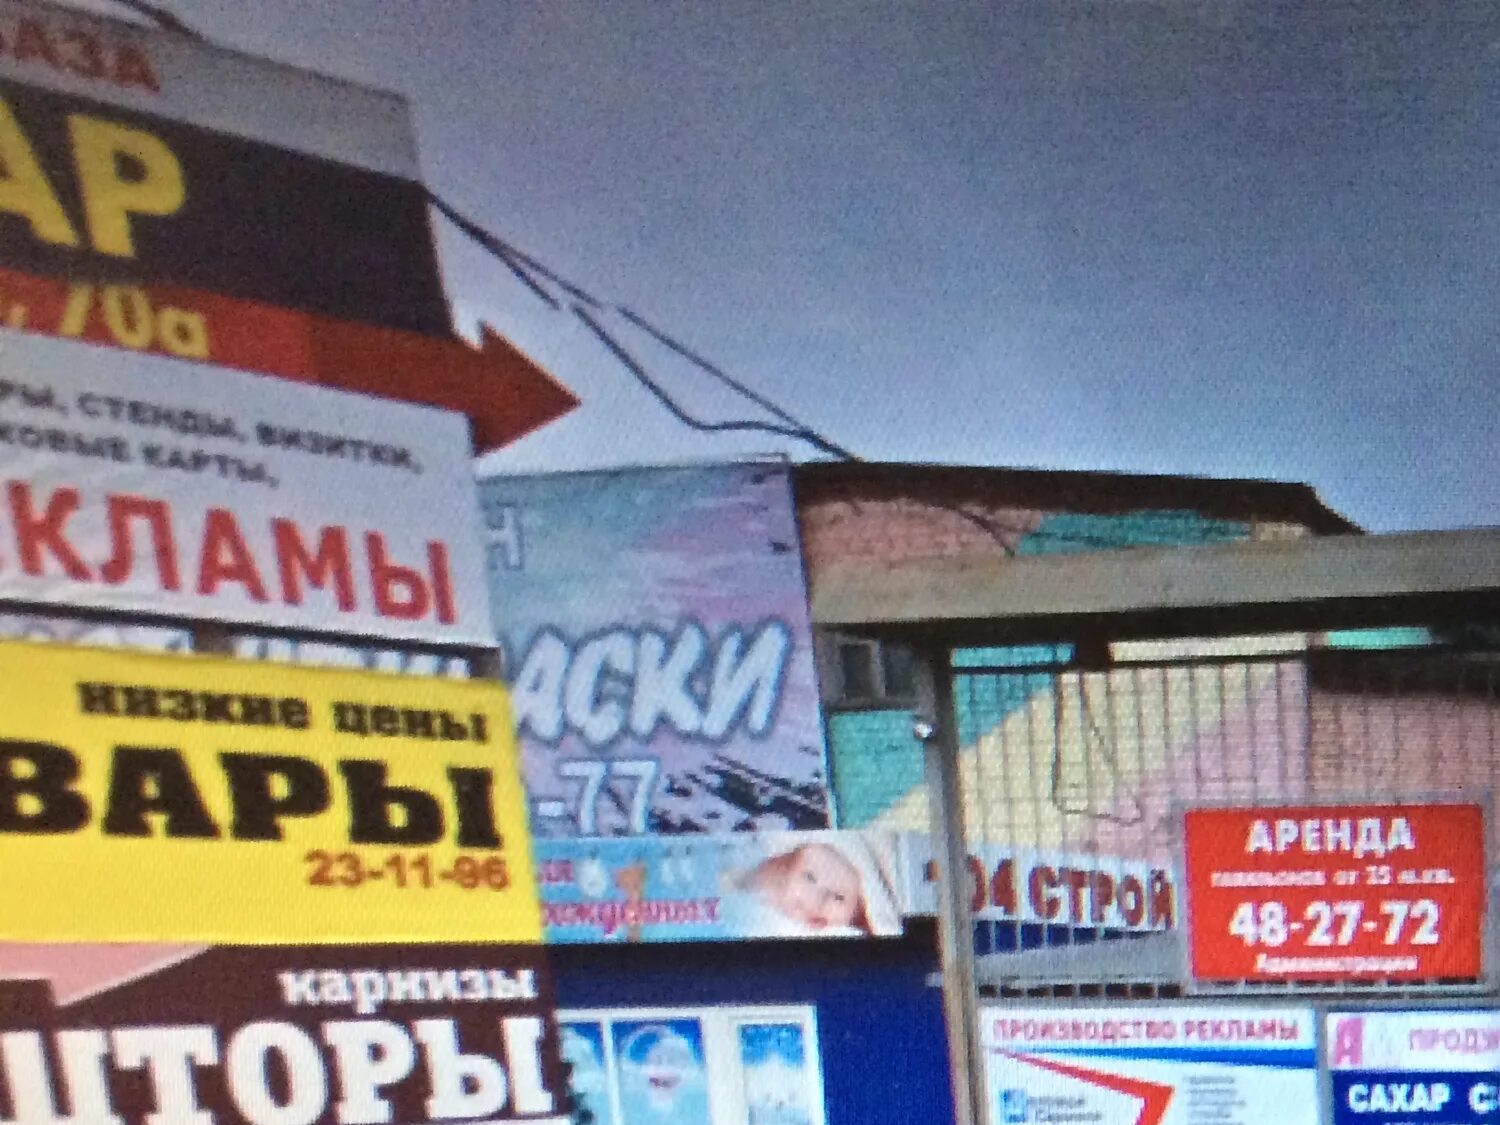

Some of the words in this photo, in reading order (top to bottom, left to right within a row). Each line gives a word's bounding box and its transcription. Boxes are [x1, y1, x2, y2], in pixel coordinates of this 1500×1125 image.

[78, 682, 313, 730] низкие
[332, 702, 489, 743] цены
[0, 740, 503, 850] ВАРЫ
[1245, 817, 1416, 859] АРЕНДА
[304, 850, 511, 892] 23-11-96
[1228, 898, 1441, 948] 48-27-72
[278, 967, 539, 1014] карнизы
[993, 1017, 1177, 1041] ПРОИЗВОДСТВО
[1184, 1019, 1300, 1041] РЕКЛАМЫ
[1348, 1082, 1451, 1114] САХАР
